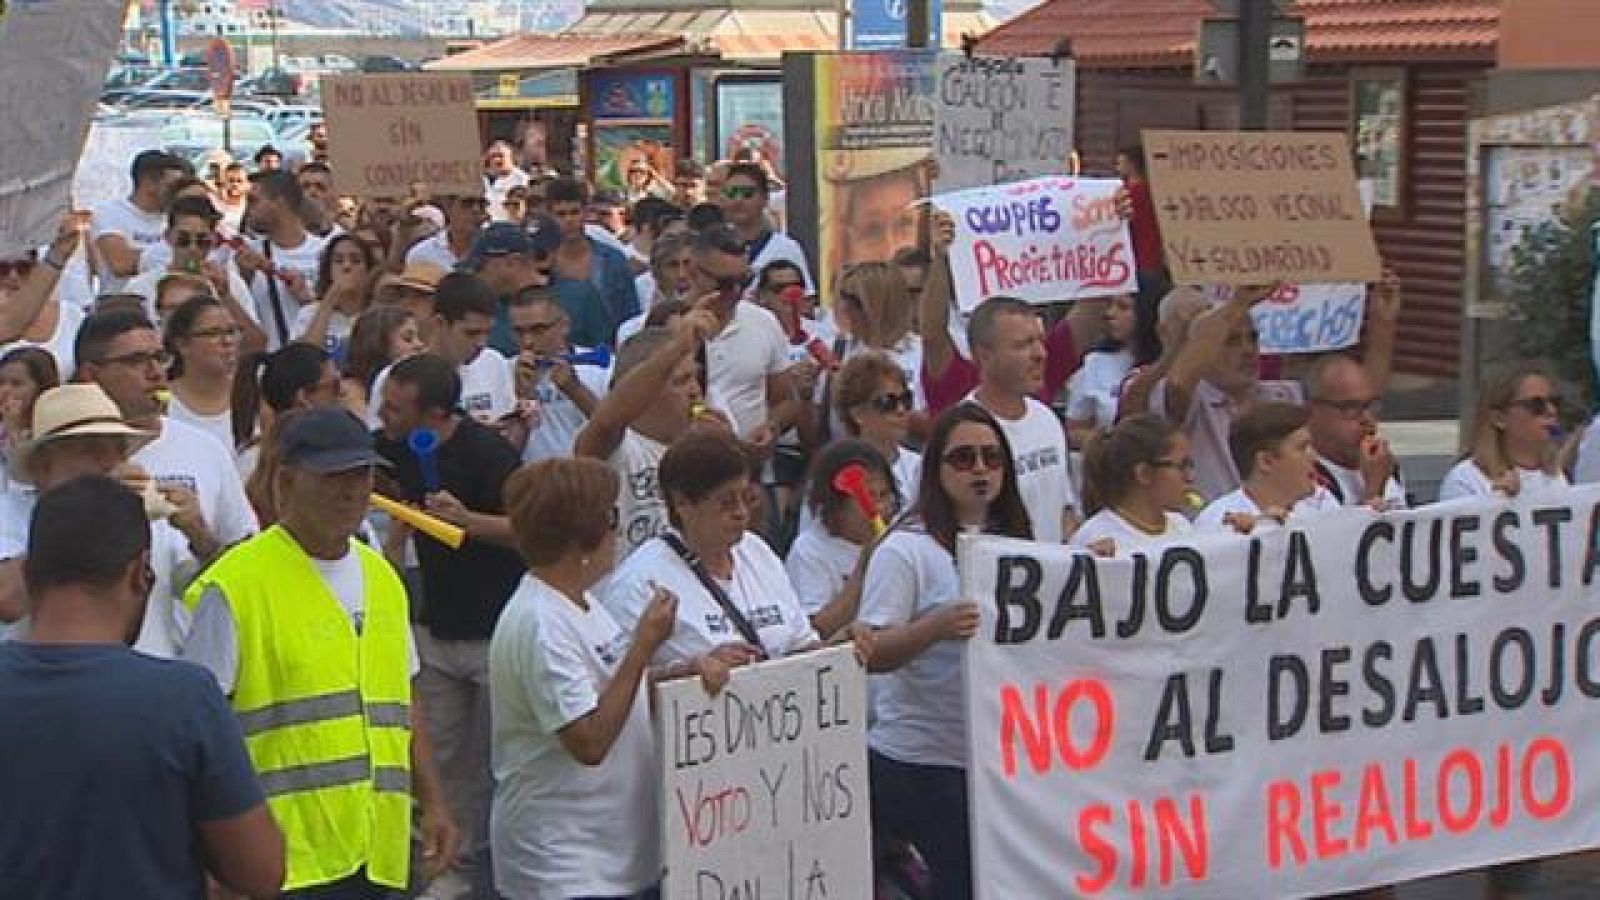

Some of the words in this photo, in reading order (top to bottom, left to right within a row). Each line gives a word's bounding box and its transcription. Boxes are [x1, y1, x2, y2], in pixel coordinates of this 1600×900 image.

[389, 118, 423, 145] SIN
[994, 547, 1208, 645] BAJO
[1244, 532, 1321, 624] LA
[674, 700, 716, 769] LES
[725, 690, 803, 754] DIMOS
[817, 665, 849, 729] EL
[1000, 678, 1114, 778] NO
[1144, 668, 1234, 761] AL
[676, 779, 750, 847] VOTO
[759, 761, 789, 828] Y
[802, 746, 854, 823] NOS
[1075, 793, 1208, 894] SIN
[1266, 736, 1572, 869] REALOJO
[786, 838, 826, 900] LA
